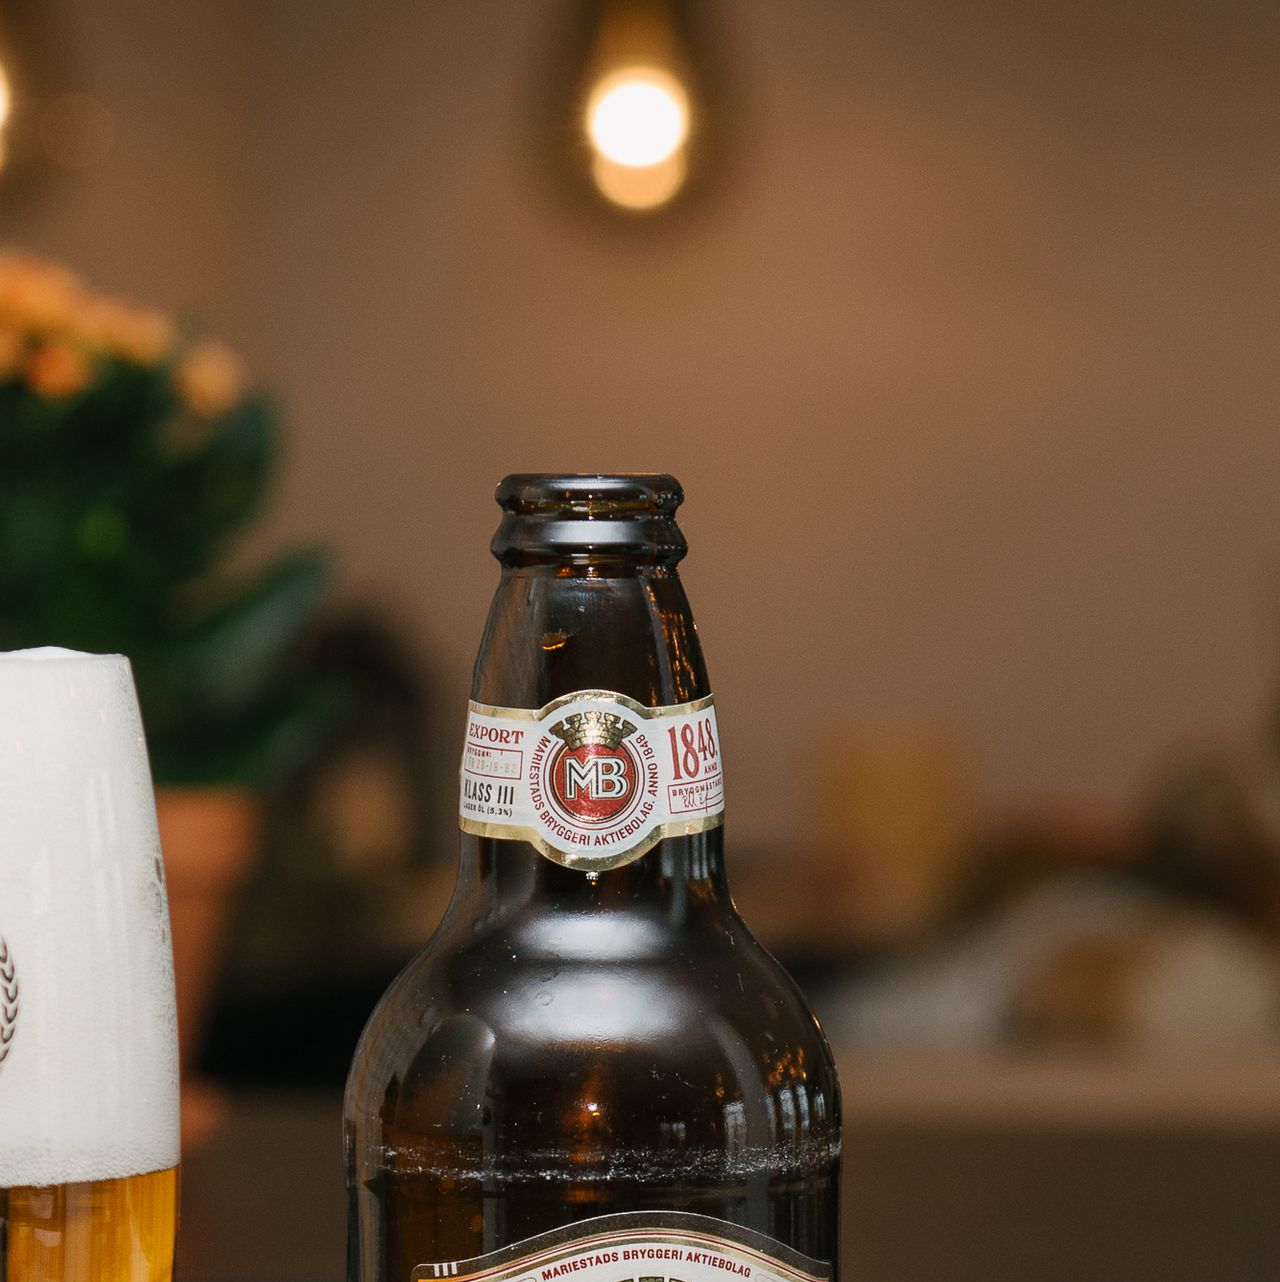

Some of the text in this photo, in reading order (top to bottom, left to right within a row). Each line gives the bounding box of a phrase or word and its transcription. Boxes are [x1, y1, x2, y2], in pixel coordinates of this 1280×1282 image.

[469, 722, 524, 744] EXPORT
[635, 734, 654, 761] 1848
[529, 735, 552, 811] MARIESTADS
[564, 755, 629, 800] MB
[647, 762, 659, 797] ANNO
[703, 761, 718, 775] ANNO
[464, 778, 515, 805] KLASS III
[539, 810, 591, 846] BRYGGERI
[541, 1248, 752, 1281] MARIESTADS BRYGGERI AKTIEBOLAG
